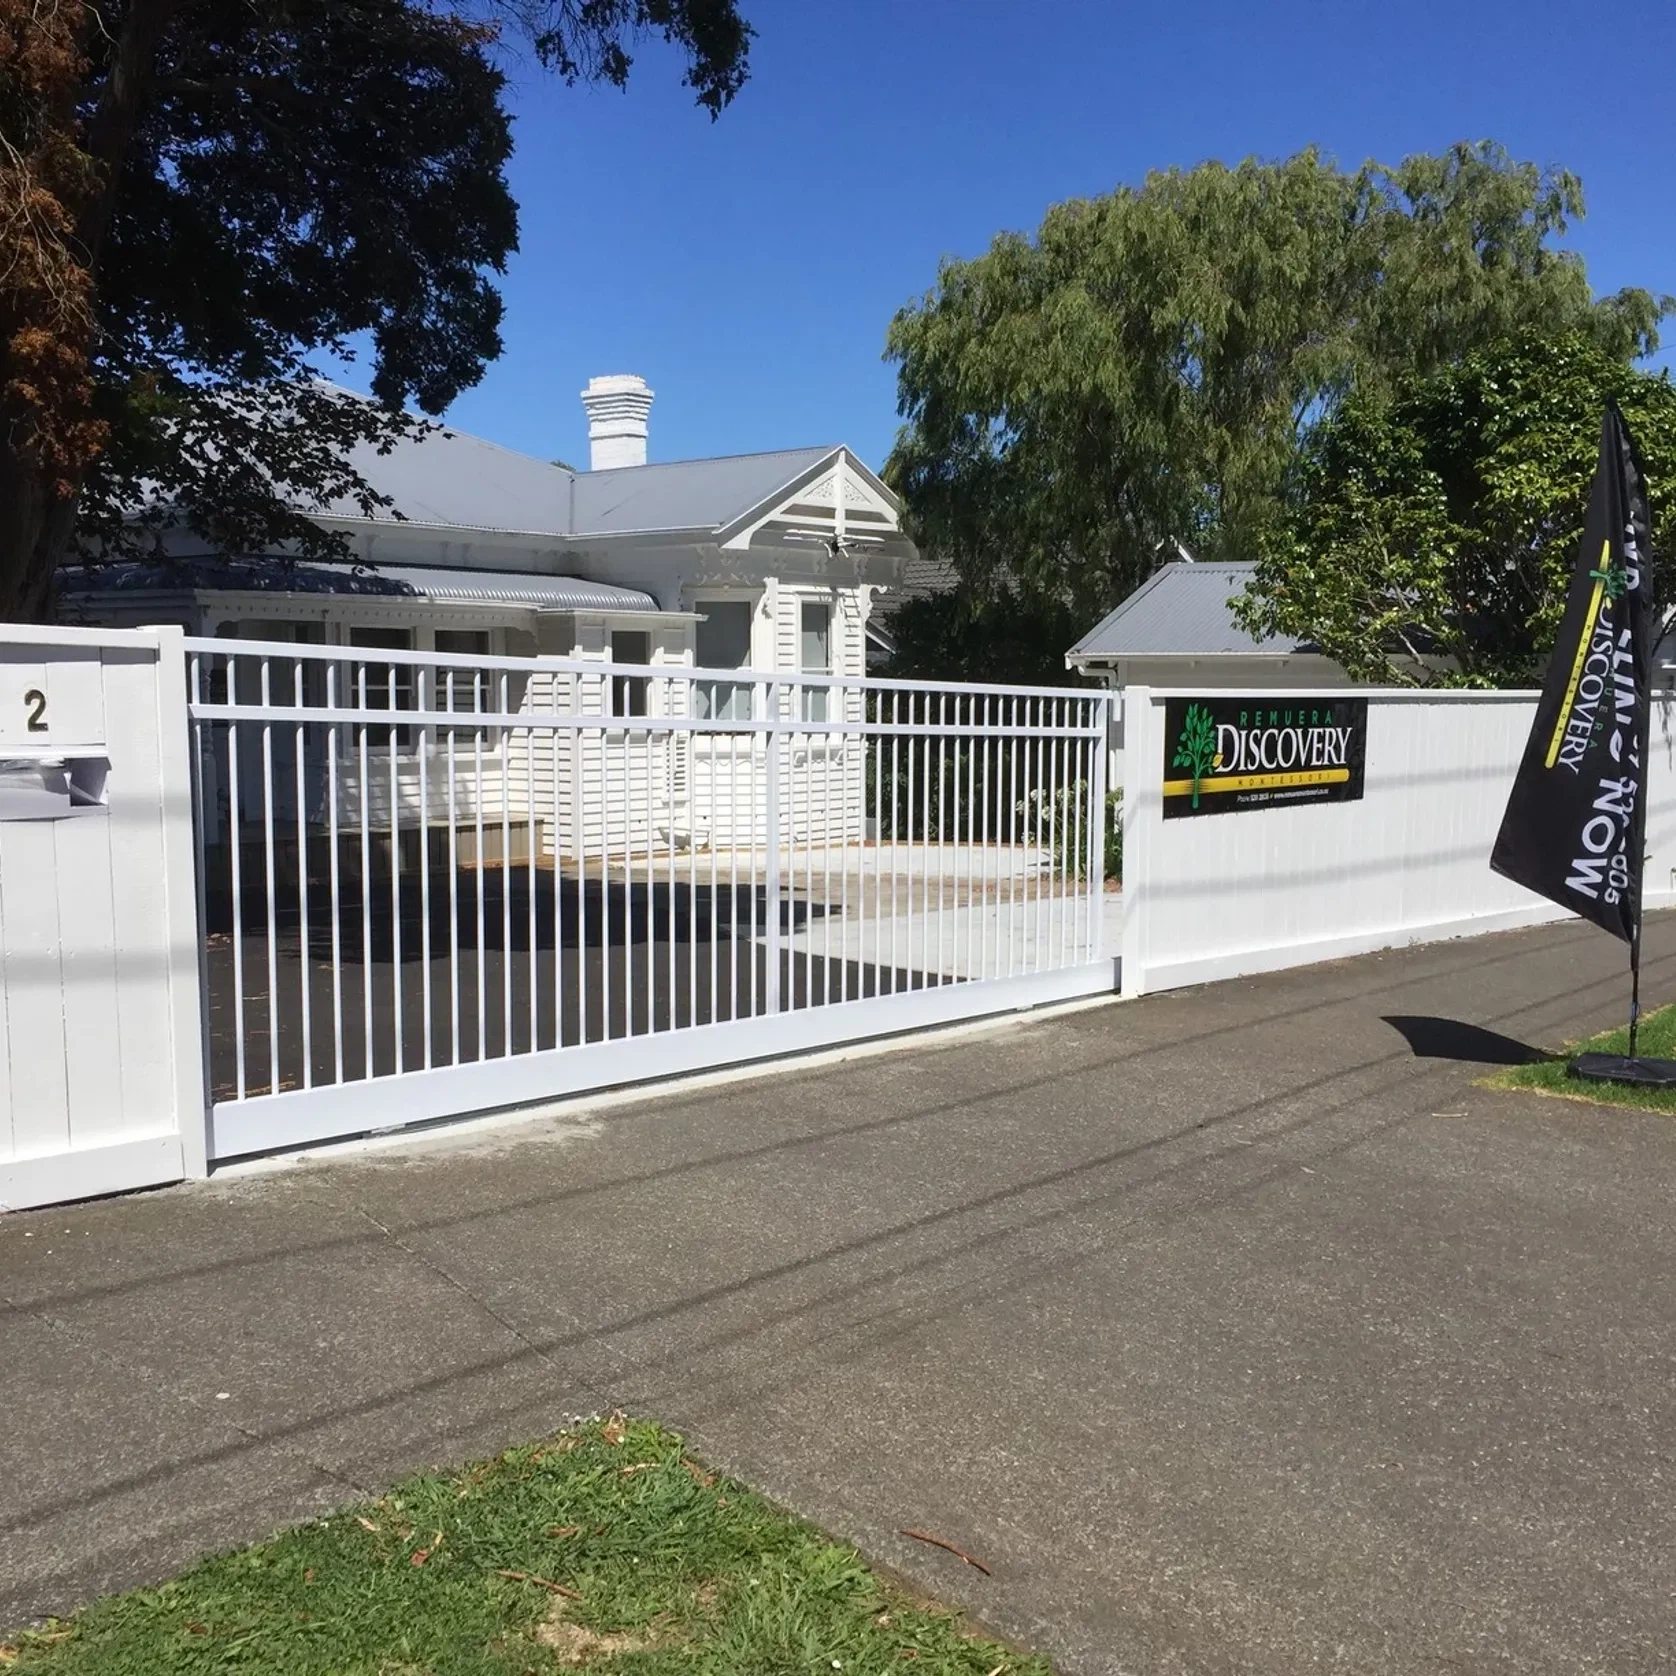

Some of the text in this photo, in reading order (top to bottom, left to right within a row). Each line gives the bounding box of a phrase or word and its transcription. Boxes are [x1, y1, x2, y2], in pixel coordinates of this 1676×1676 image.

[24, 689, 49, 732] 2
[1241, 711, 1333, 726] REMUERA
[1588, 668, 1614, 748] UERA
[1214, 724, 1353, 773] DISCOVERY
[1238, 774, 1330, 786] MONTESSORI
[1564, 778, 1625, 900] NOW
